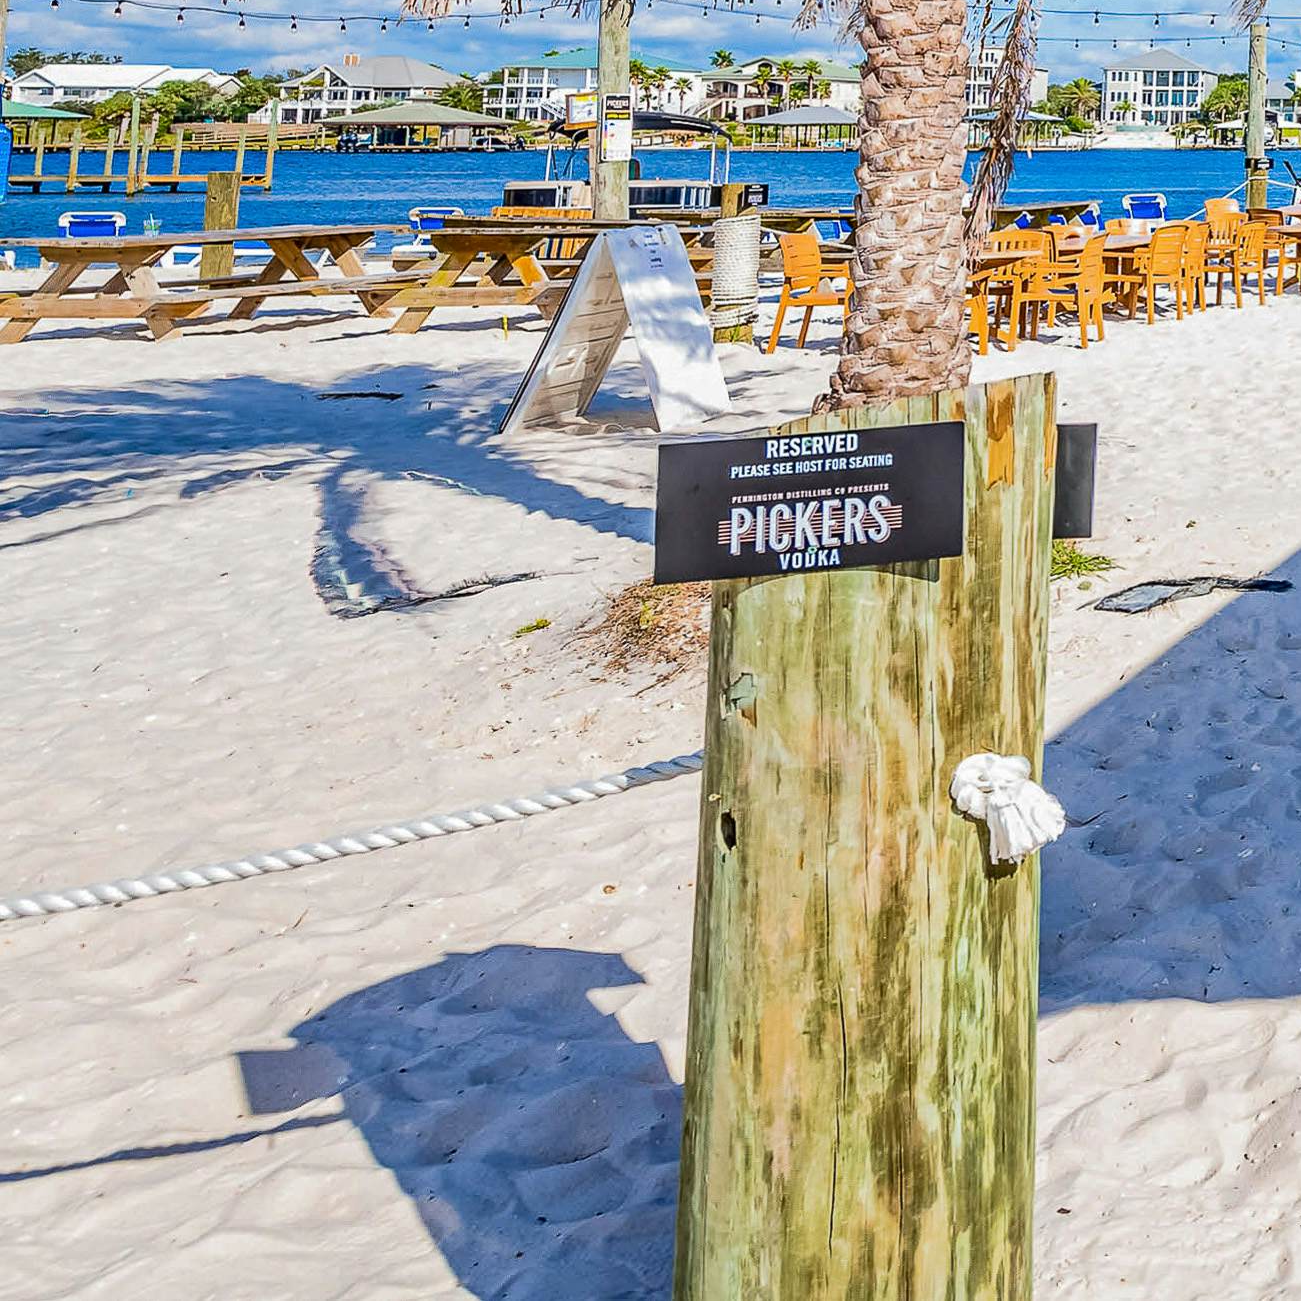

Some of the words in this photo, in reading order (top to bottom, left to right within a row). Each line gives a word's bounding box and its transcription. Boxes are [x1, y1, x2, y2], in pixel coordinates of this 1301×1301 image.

[766, 433, 858, 459] RESERVED
[730, 464, 771, 479] PLEASE
[772, 462, 793, 475] SEE
[795, 460, 823, 474] HOST
[825, 458, 847, 470] FOR
[849, 454, 893, 469] SEATING
[731, 493, 783, 504] PENNINGTON
[785, 489, 832, 499] DISTILLING
[847, 483, 890, 493] PRESENTS
[730, 495, 892, 556] PICKERS
[779, 549, 841, 570] VODKA
